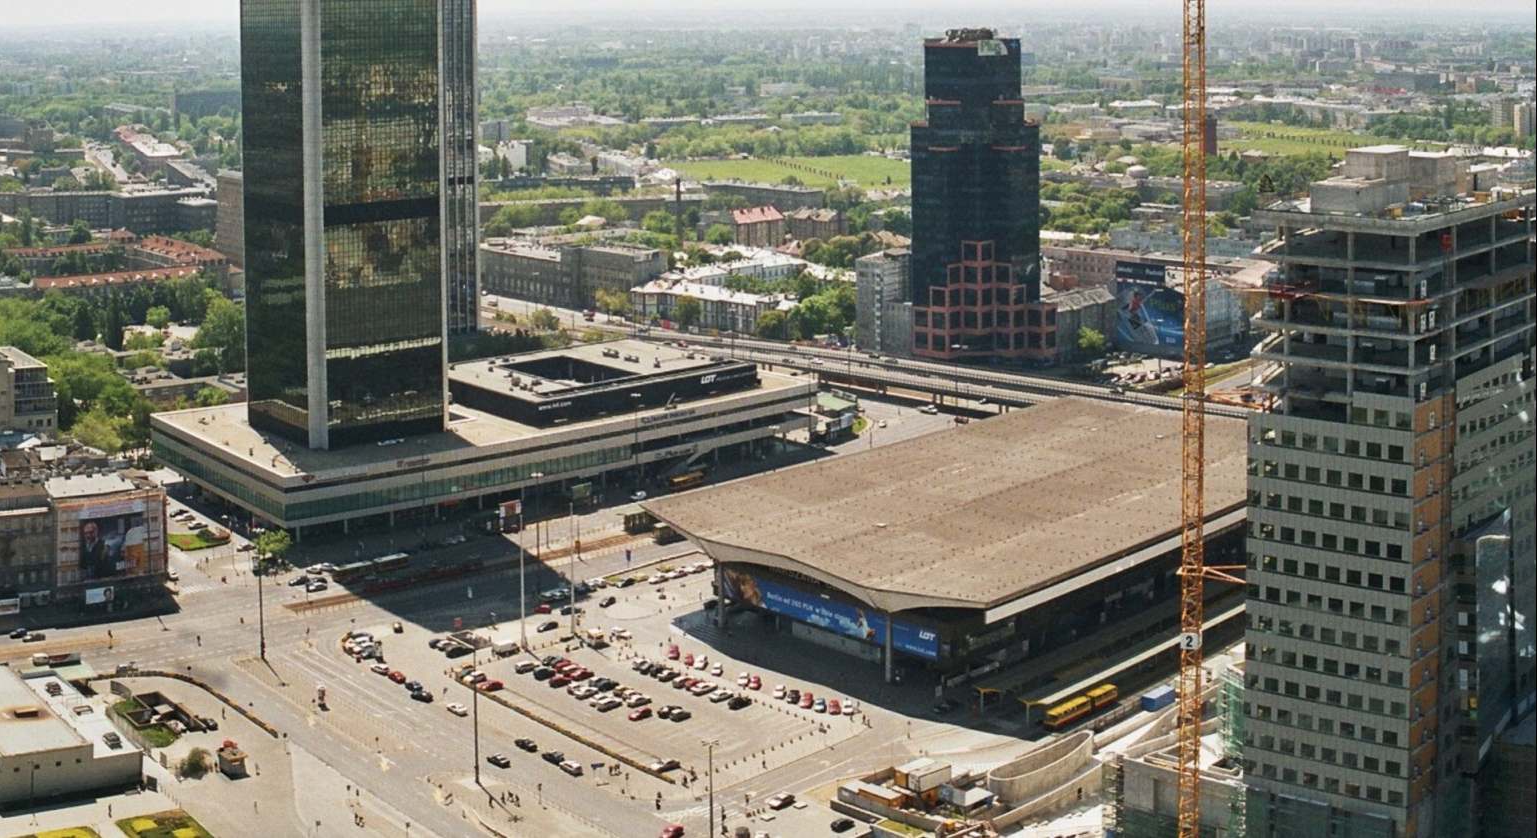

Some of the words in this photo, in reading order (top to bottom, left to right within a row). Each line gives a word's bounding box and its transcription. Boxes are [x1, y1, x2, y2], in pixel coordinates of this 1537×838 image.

[700, 374, 717, 385] LOT
[918, 629, 937, 641] LOT
[1185, 635, 1193, 648] 2
